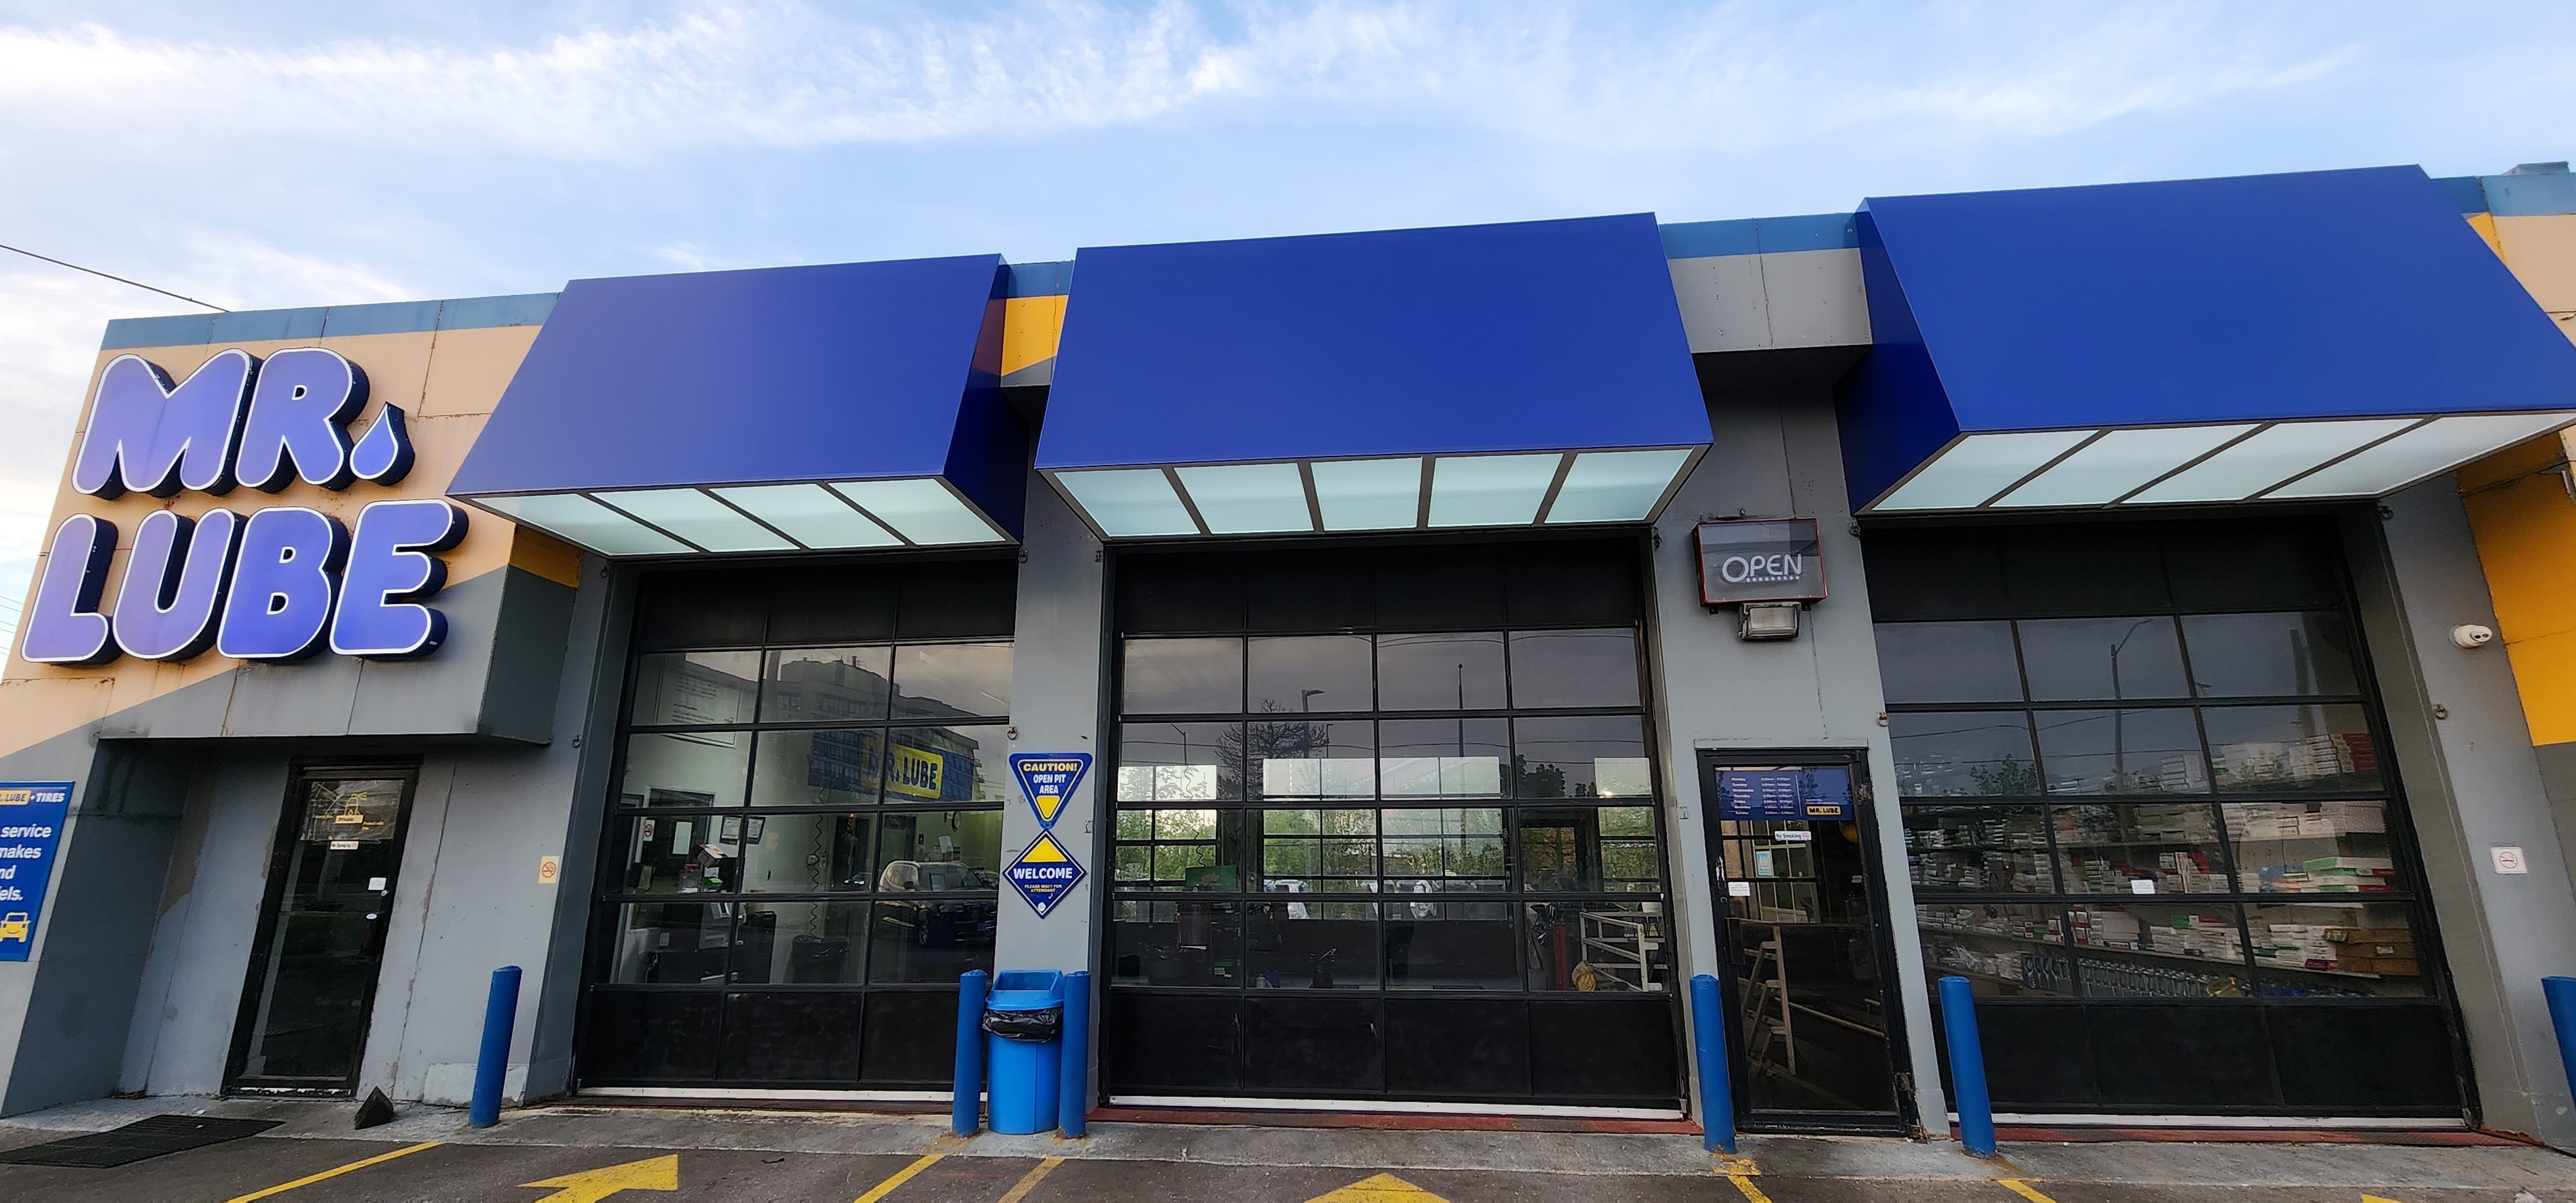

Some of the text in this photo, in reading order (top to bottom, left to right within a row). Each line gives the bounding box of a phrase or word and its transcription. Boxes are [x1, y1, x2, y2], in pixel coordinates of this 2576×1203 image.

[71, 348, 415, 500] MR.
[1722, 554, 1802, 582] OPEN
[21, 498, 469, 665] LUBE
[902, 755, 939, 791] LUBE
[1023, 763, 1077, 772] CAUTION!
[1033, 774, 1066, 783] OPEN PIT
[1039, 784, 1059, 794] AREA
[5, 793, 27, 802] LUBE
[0, 824, 52, 838] service
[0, 865, 17, 879] nd
[1013, 867, 1073, 879] WELCOME
[0, 886, 23, 900] els.
